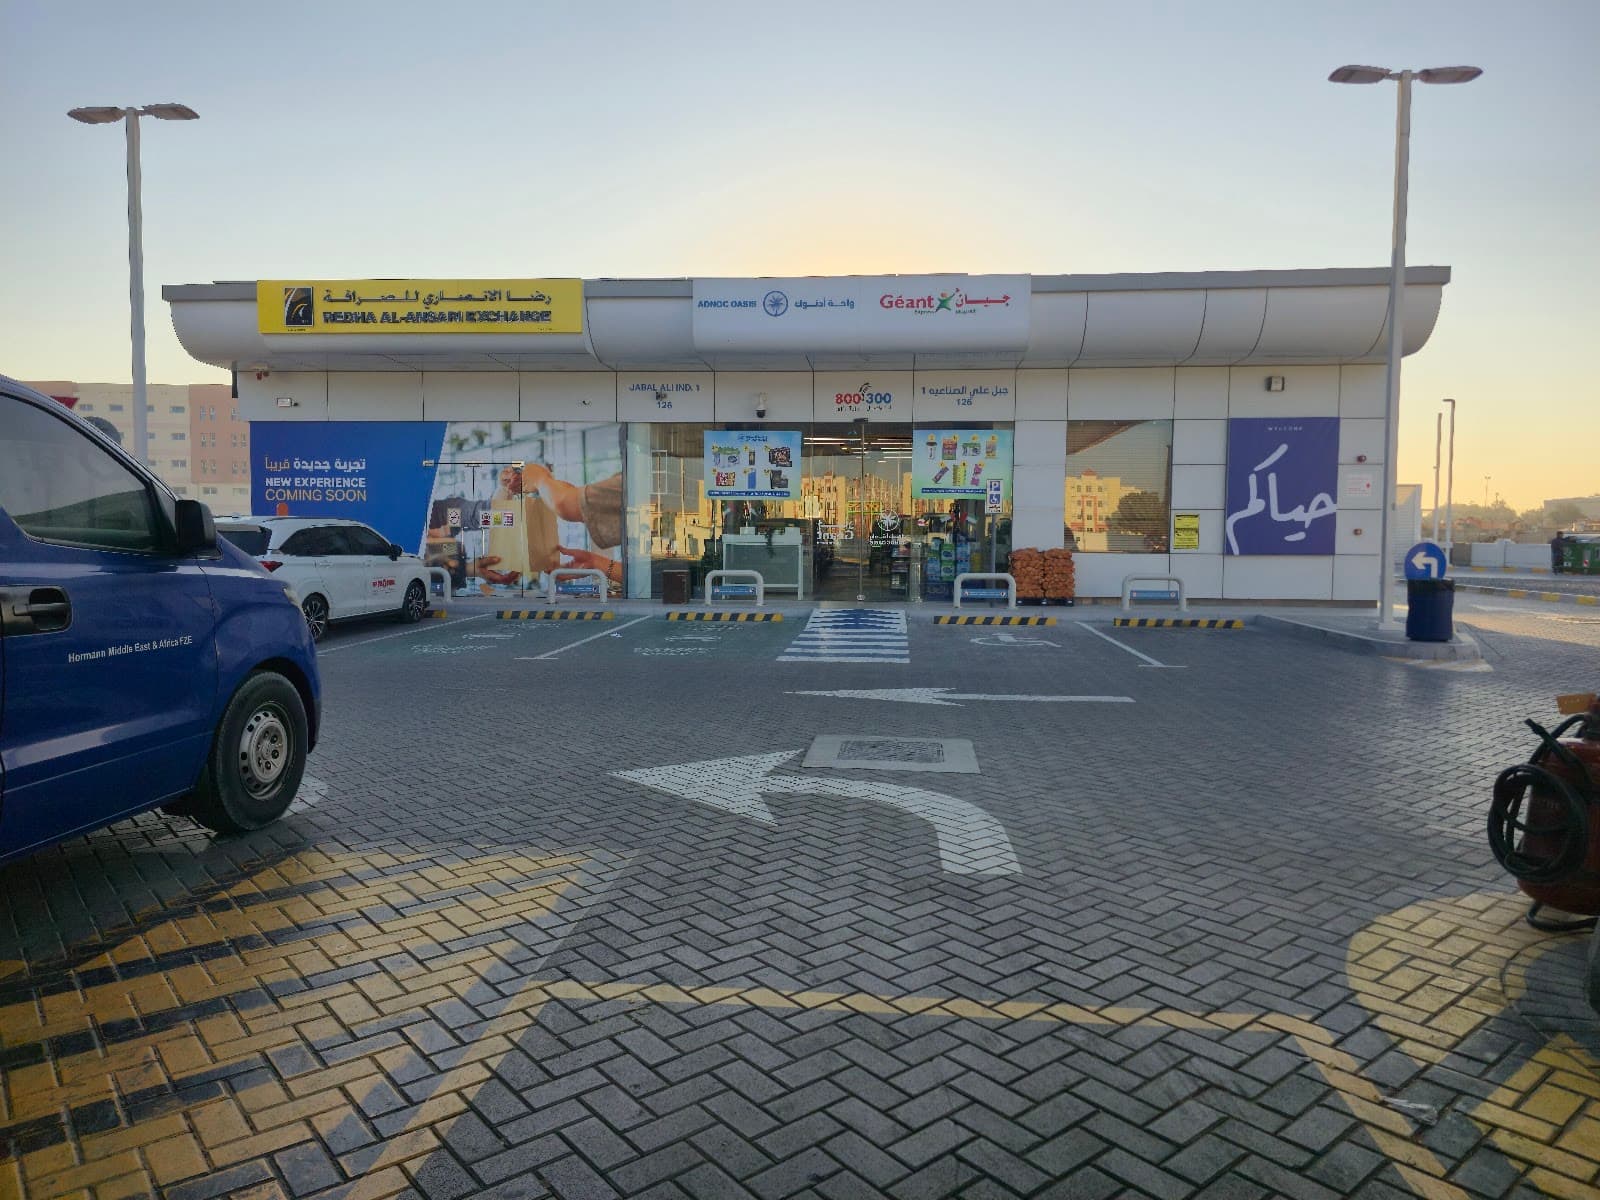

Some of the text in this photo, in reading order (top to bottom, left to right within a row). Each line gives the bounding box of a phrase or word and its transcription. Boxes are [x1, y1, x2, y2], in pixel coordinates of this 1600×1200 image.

[697, 300, 757, 309] ADNOC OASIS
[879, 294, 935, 309] Géant
[322, 309, 552, 324] REDHA AL-ANSARI EXCHANGE
[629, 383, 658, 392] JABAL
[656, 401, 673, 409] 126
[835, 392, 892, 405] 800 300
[292, 457, 331, 473] جديدة
[334, 458, 366, 473] تجربة
[265, 477, 367, 488] NEW EXPERIENCE
[265, 488, 368, 502] COMING SOON
[108, 645, 133, 657] Middle
[134, 643, 151, 652] East
[159, 639, 179, 649] Africa
